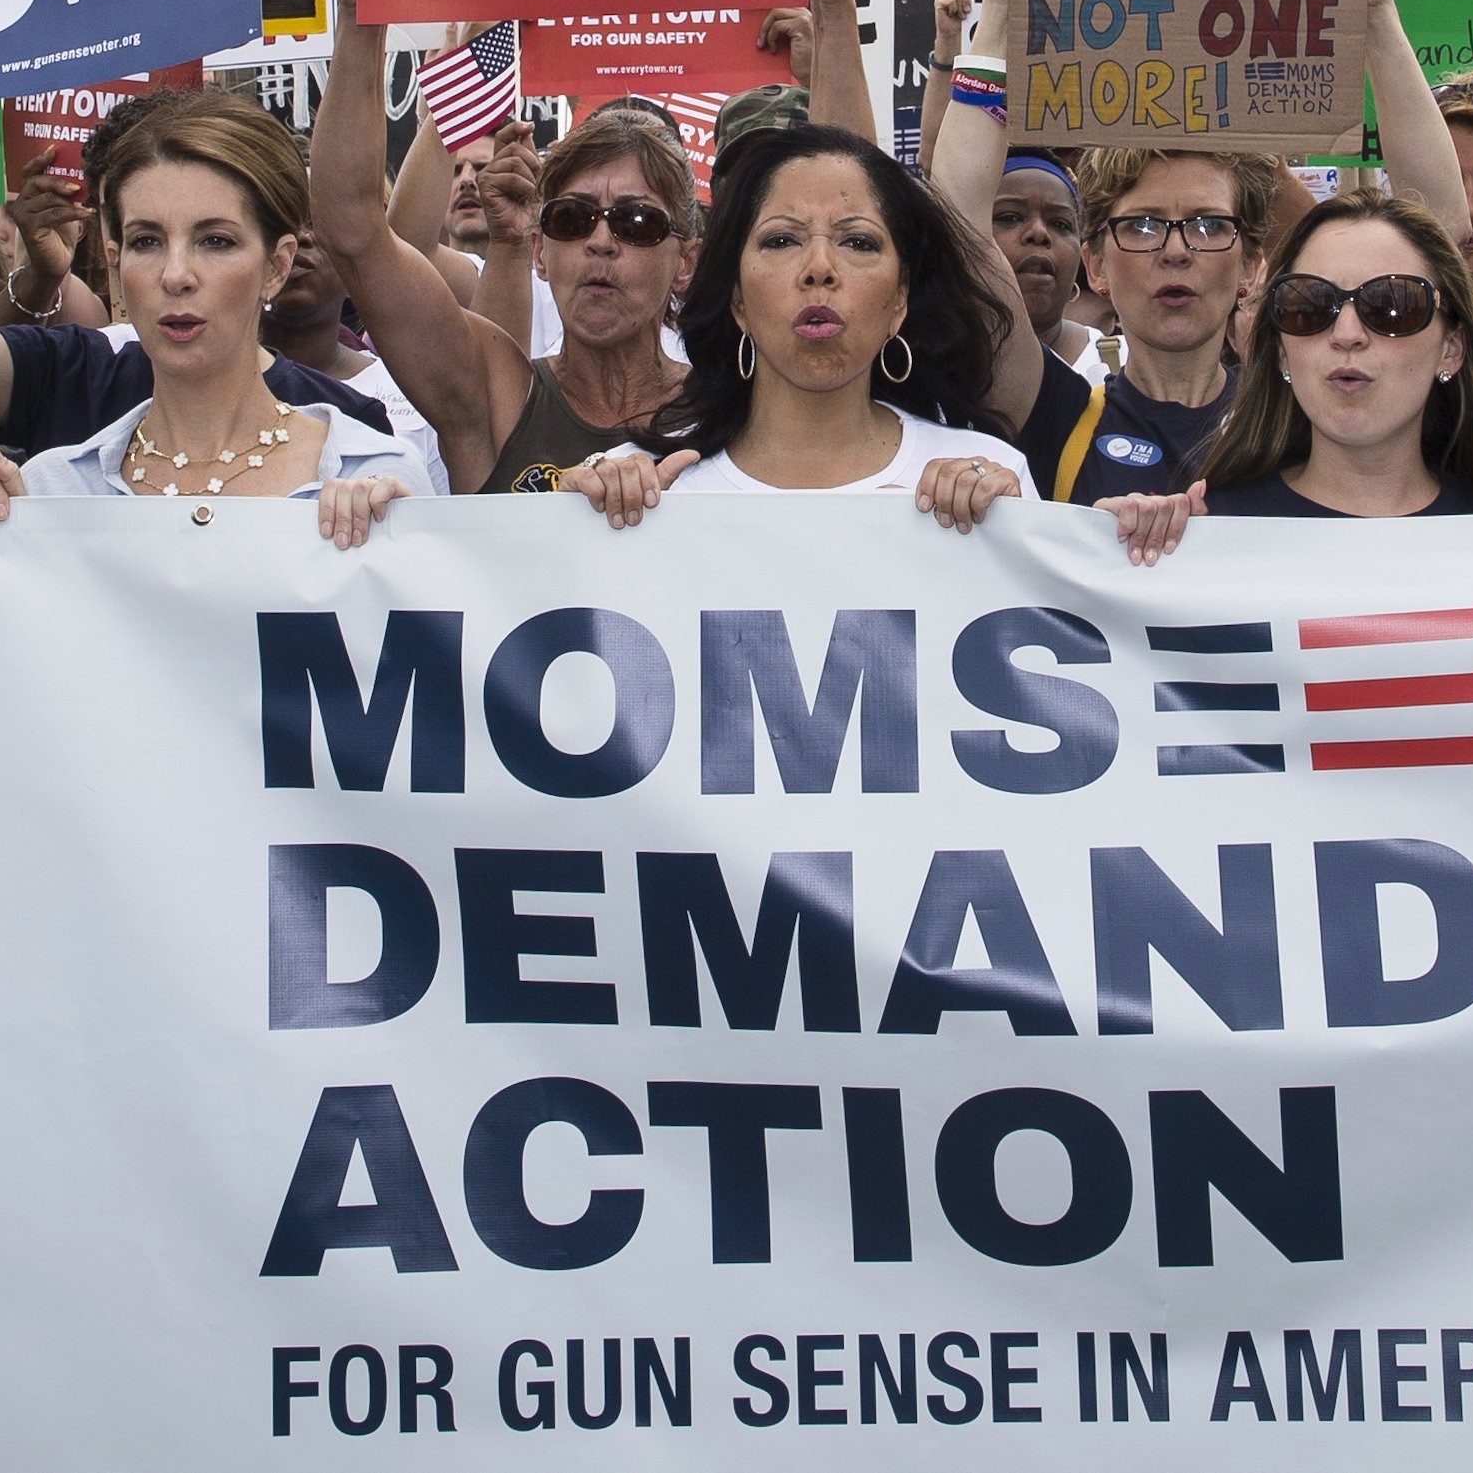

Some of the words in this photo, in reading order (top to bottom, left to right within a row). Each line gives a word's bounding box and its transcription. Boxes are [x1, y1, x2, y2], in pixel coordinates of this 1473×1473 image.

[1, 33, 142, 74] www.gunsensevoter.org
[570, 34, 602, 46] FOR
[606, 33, 642, 45] GUN
[645, 31, 706, 44] SAFETY
[596, 64, 684, 75] www.everytown.org
[1286, 62, 1335, 82] MOMS
[1025, 59, 1230, 134] MORE!
[1247, 81, 1334, 100] DEMAND
[1247, 98, 1333, 116] ACTION
[256, 605, 1120, 798] MOMS
[259, 1075, 1344, 1278] ACTION
[271, 1343, 455, 1436] FOR
[497, 1335, 692, 1430] GUN
[732, 1331, 1043, 1428] SENSE
[1077, 1331, 1169, 1423] IN
